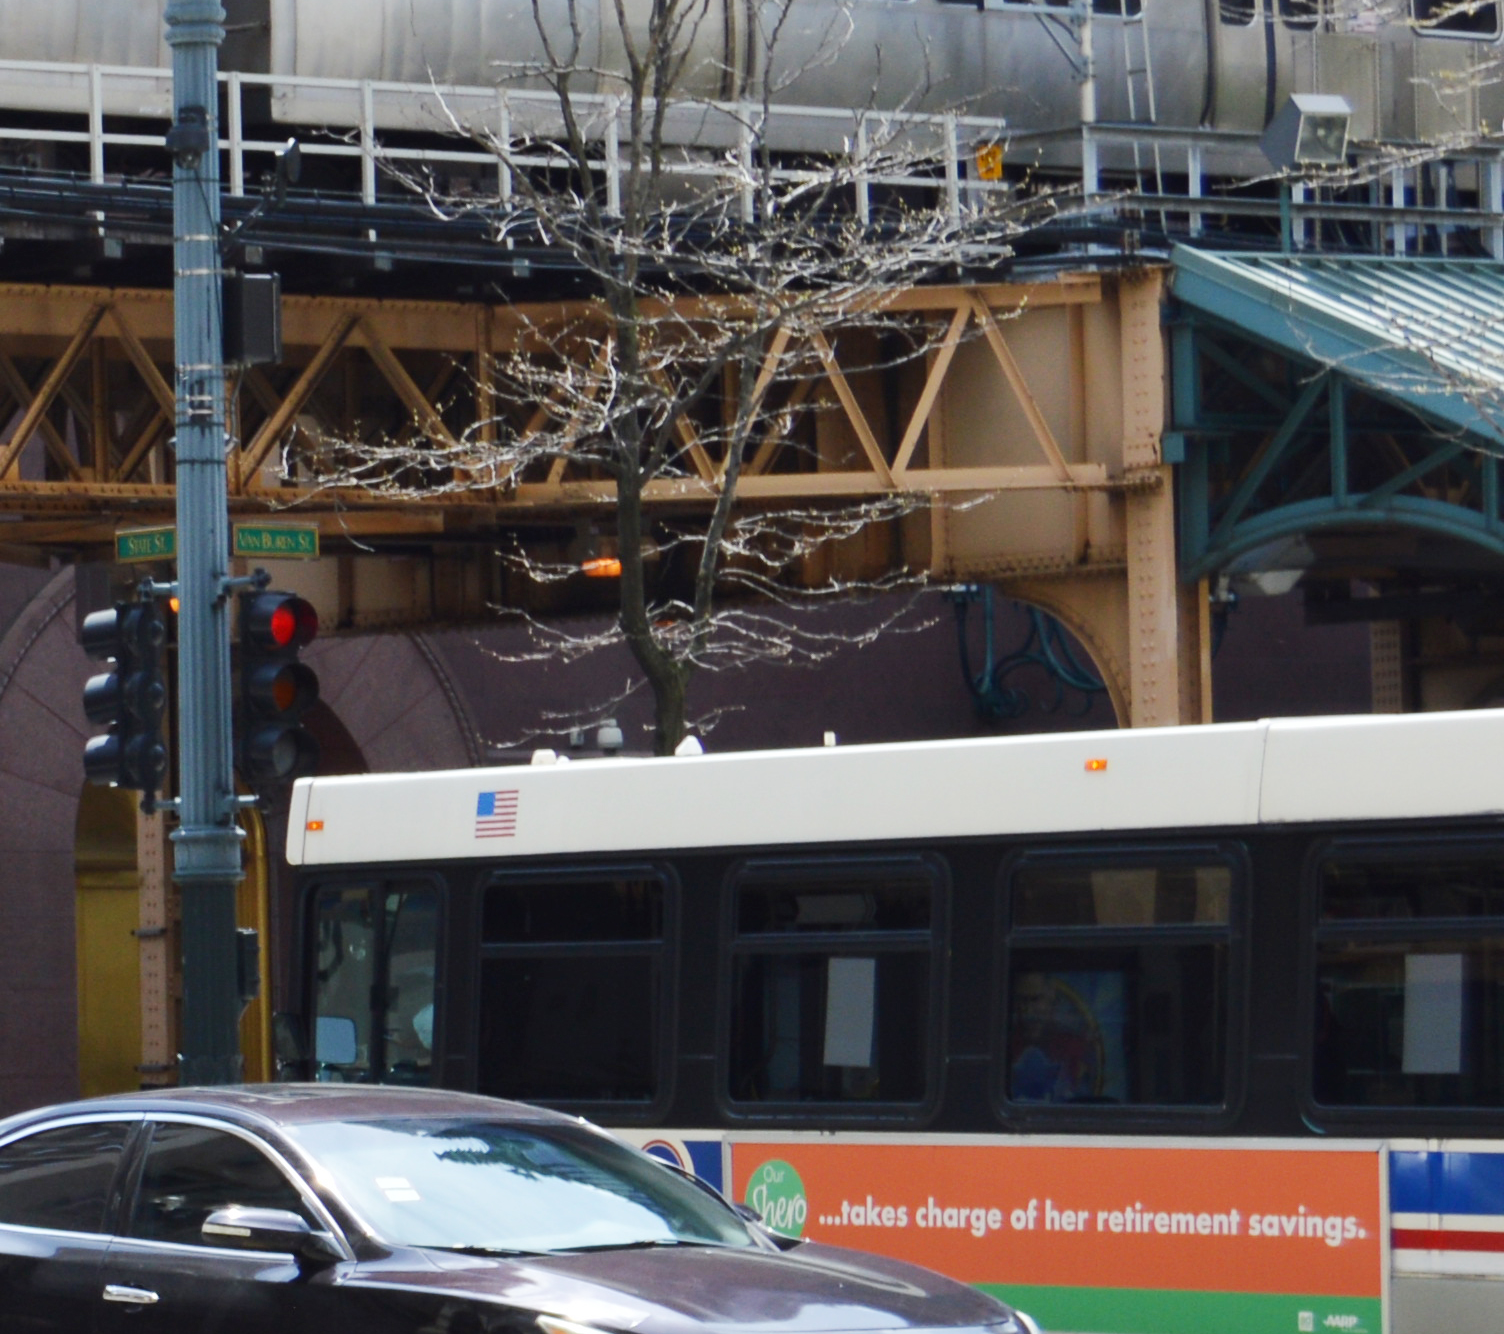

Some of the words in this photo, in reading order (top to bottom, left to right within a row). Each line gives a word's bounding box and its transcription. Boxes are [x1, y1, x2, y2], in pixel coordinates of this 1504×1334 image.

[763, 1166, 785, 1183] Our
[915, 1196, 1001, 1237] charge
[1010, 1198, 1037, 1230] of
[1045, 1199, 1089, 1232] her
[1097, 1202, 1241, 1236] retirement
[1248, 1205, 1367, 1247] savings.
